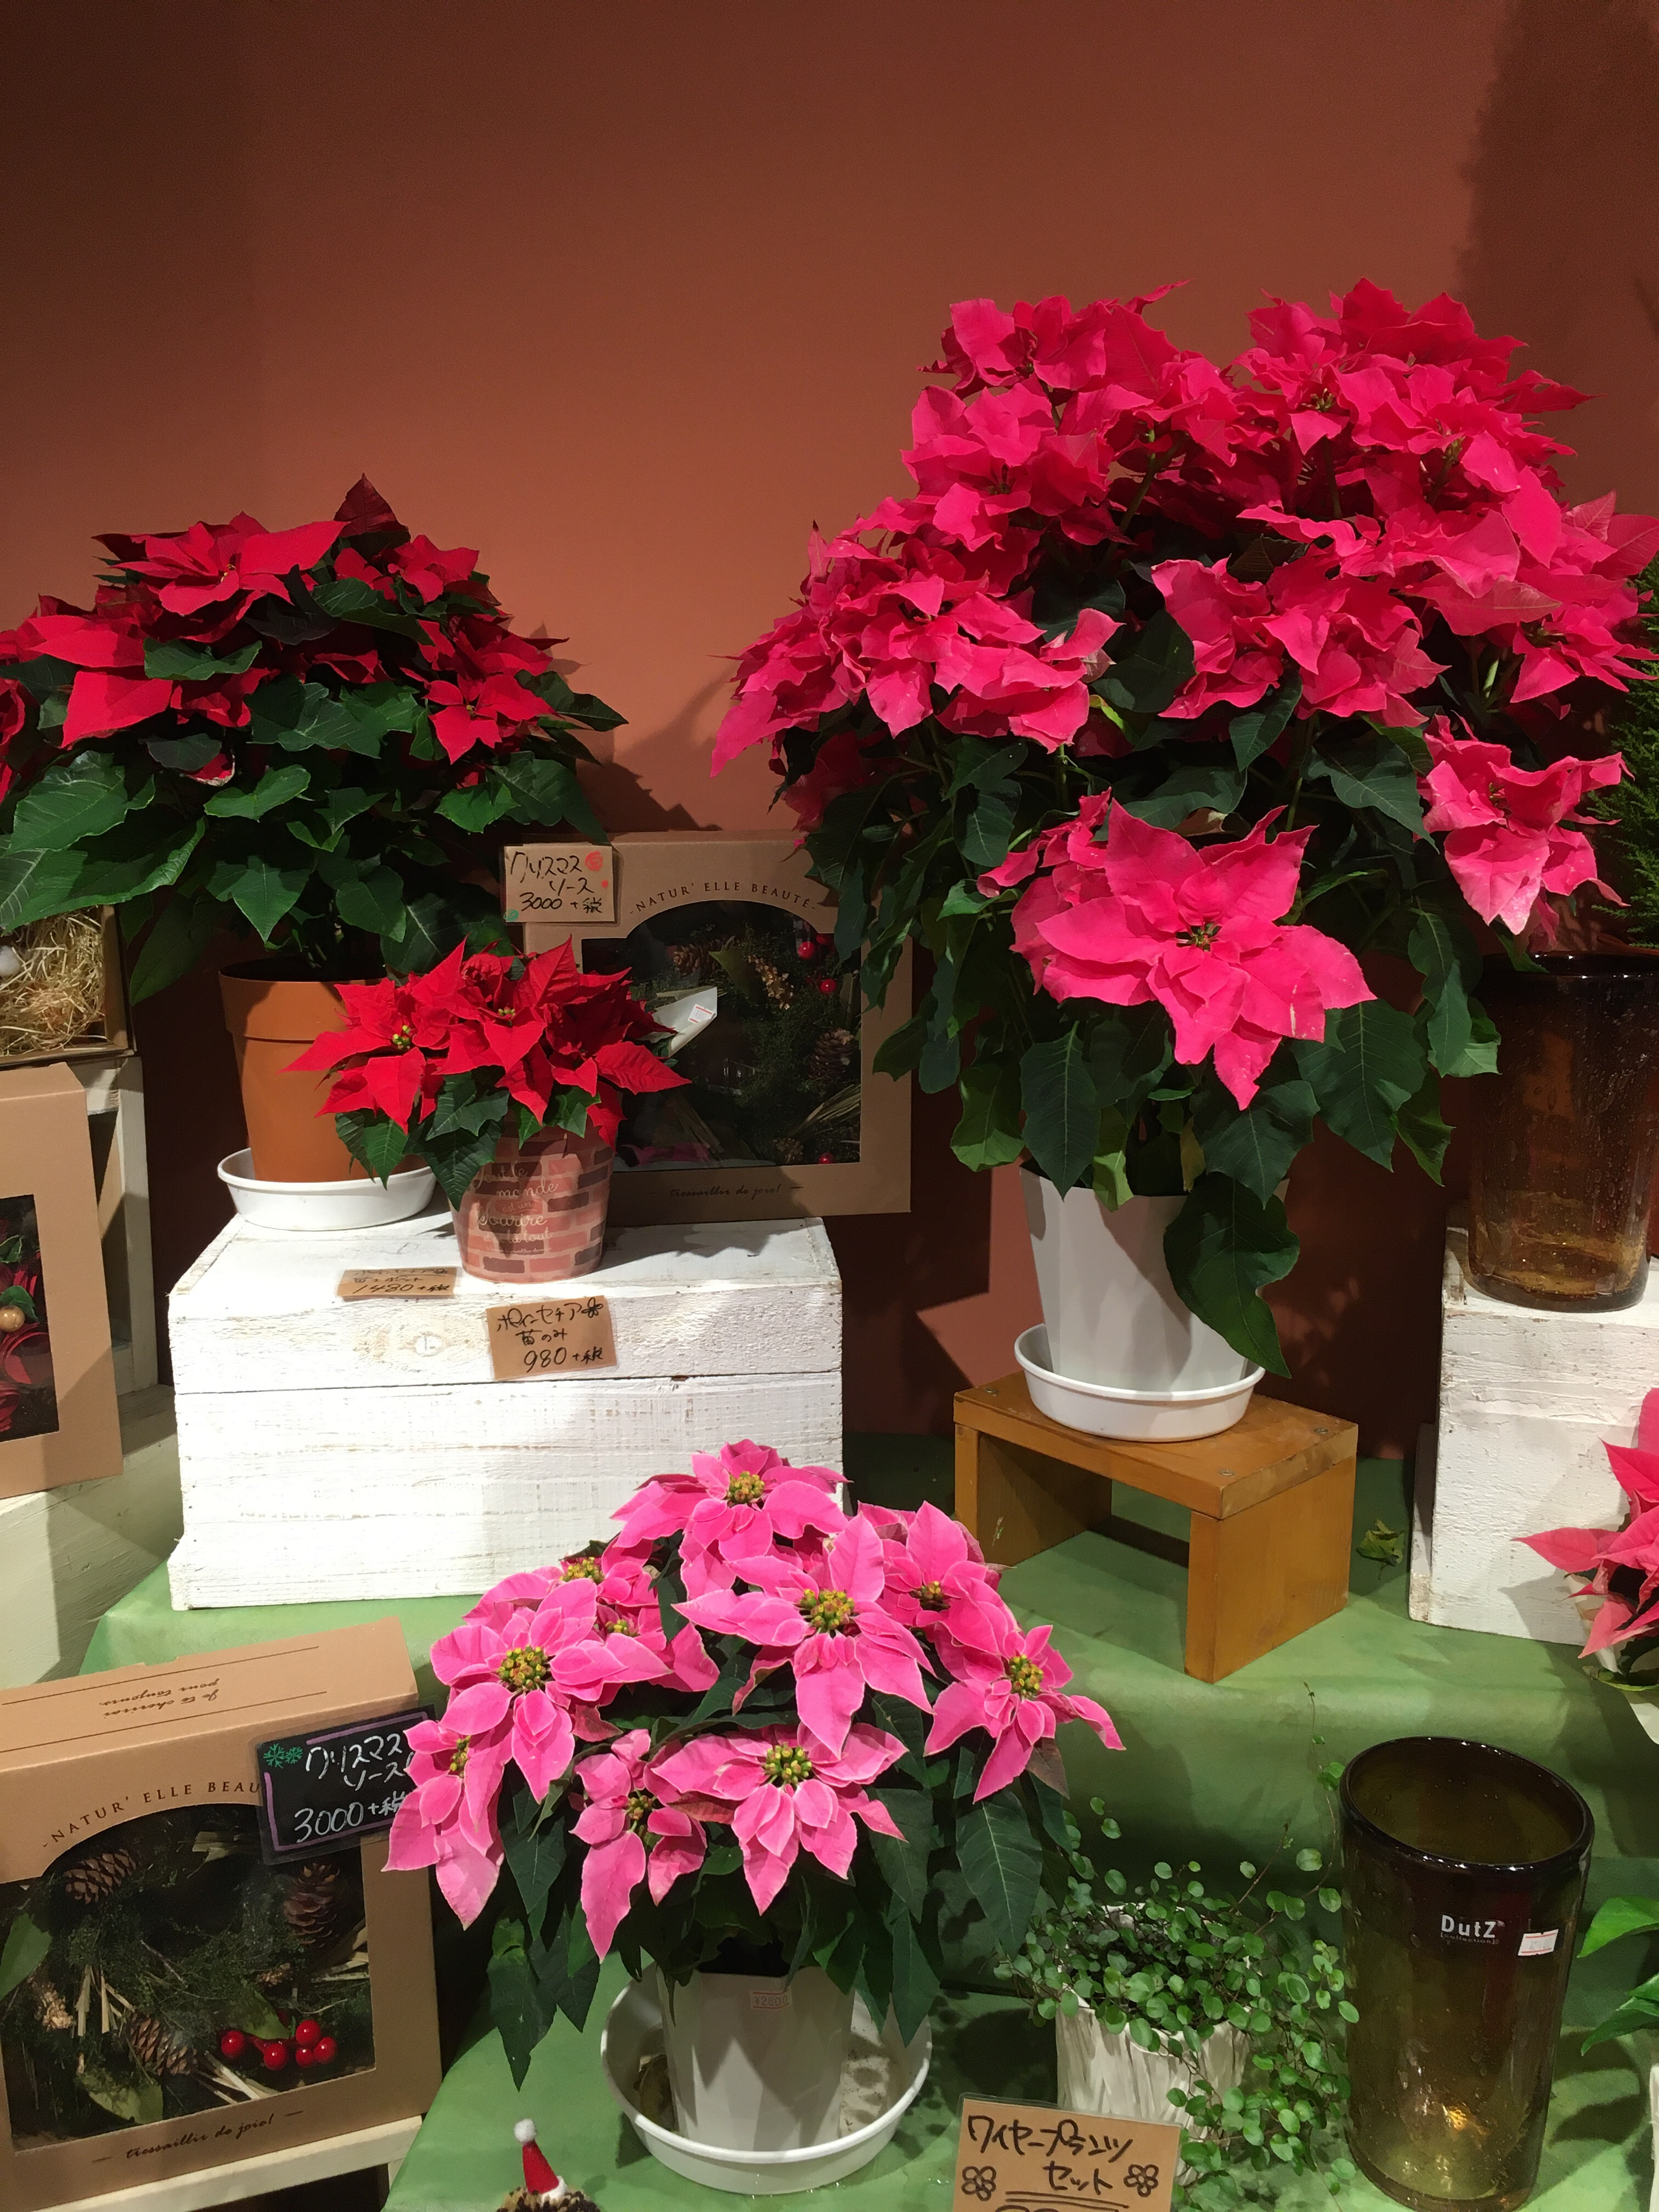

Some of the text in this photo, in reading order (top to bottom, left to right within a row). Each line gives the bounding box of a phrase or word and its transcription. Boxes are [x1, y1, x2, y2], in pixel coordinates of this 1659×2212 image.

[704, 882, 740, 891] ELLE
[496, 1176, 558, 1198] monde
[515, 1328, 568, 1346] 苗のみ
[143, 1784, 192, 1803] ELLE
[208, 1781, 261, 1793] BEAU
[1043, 2160, 1113, 2195] セット
